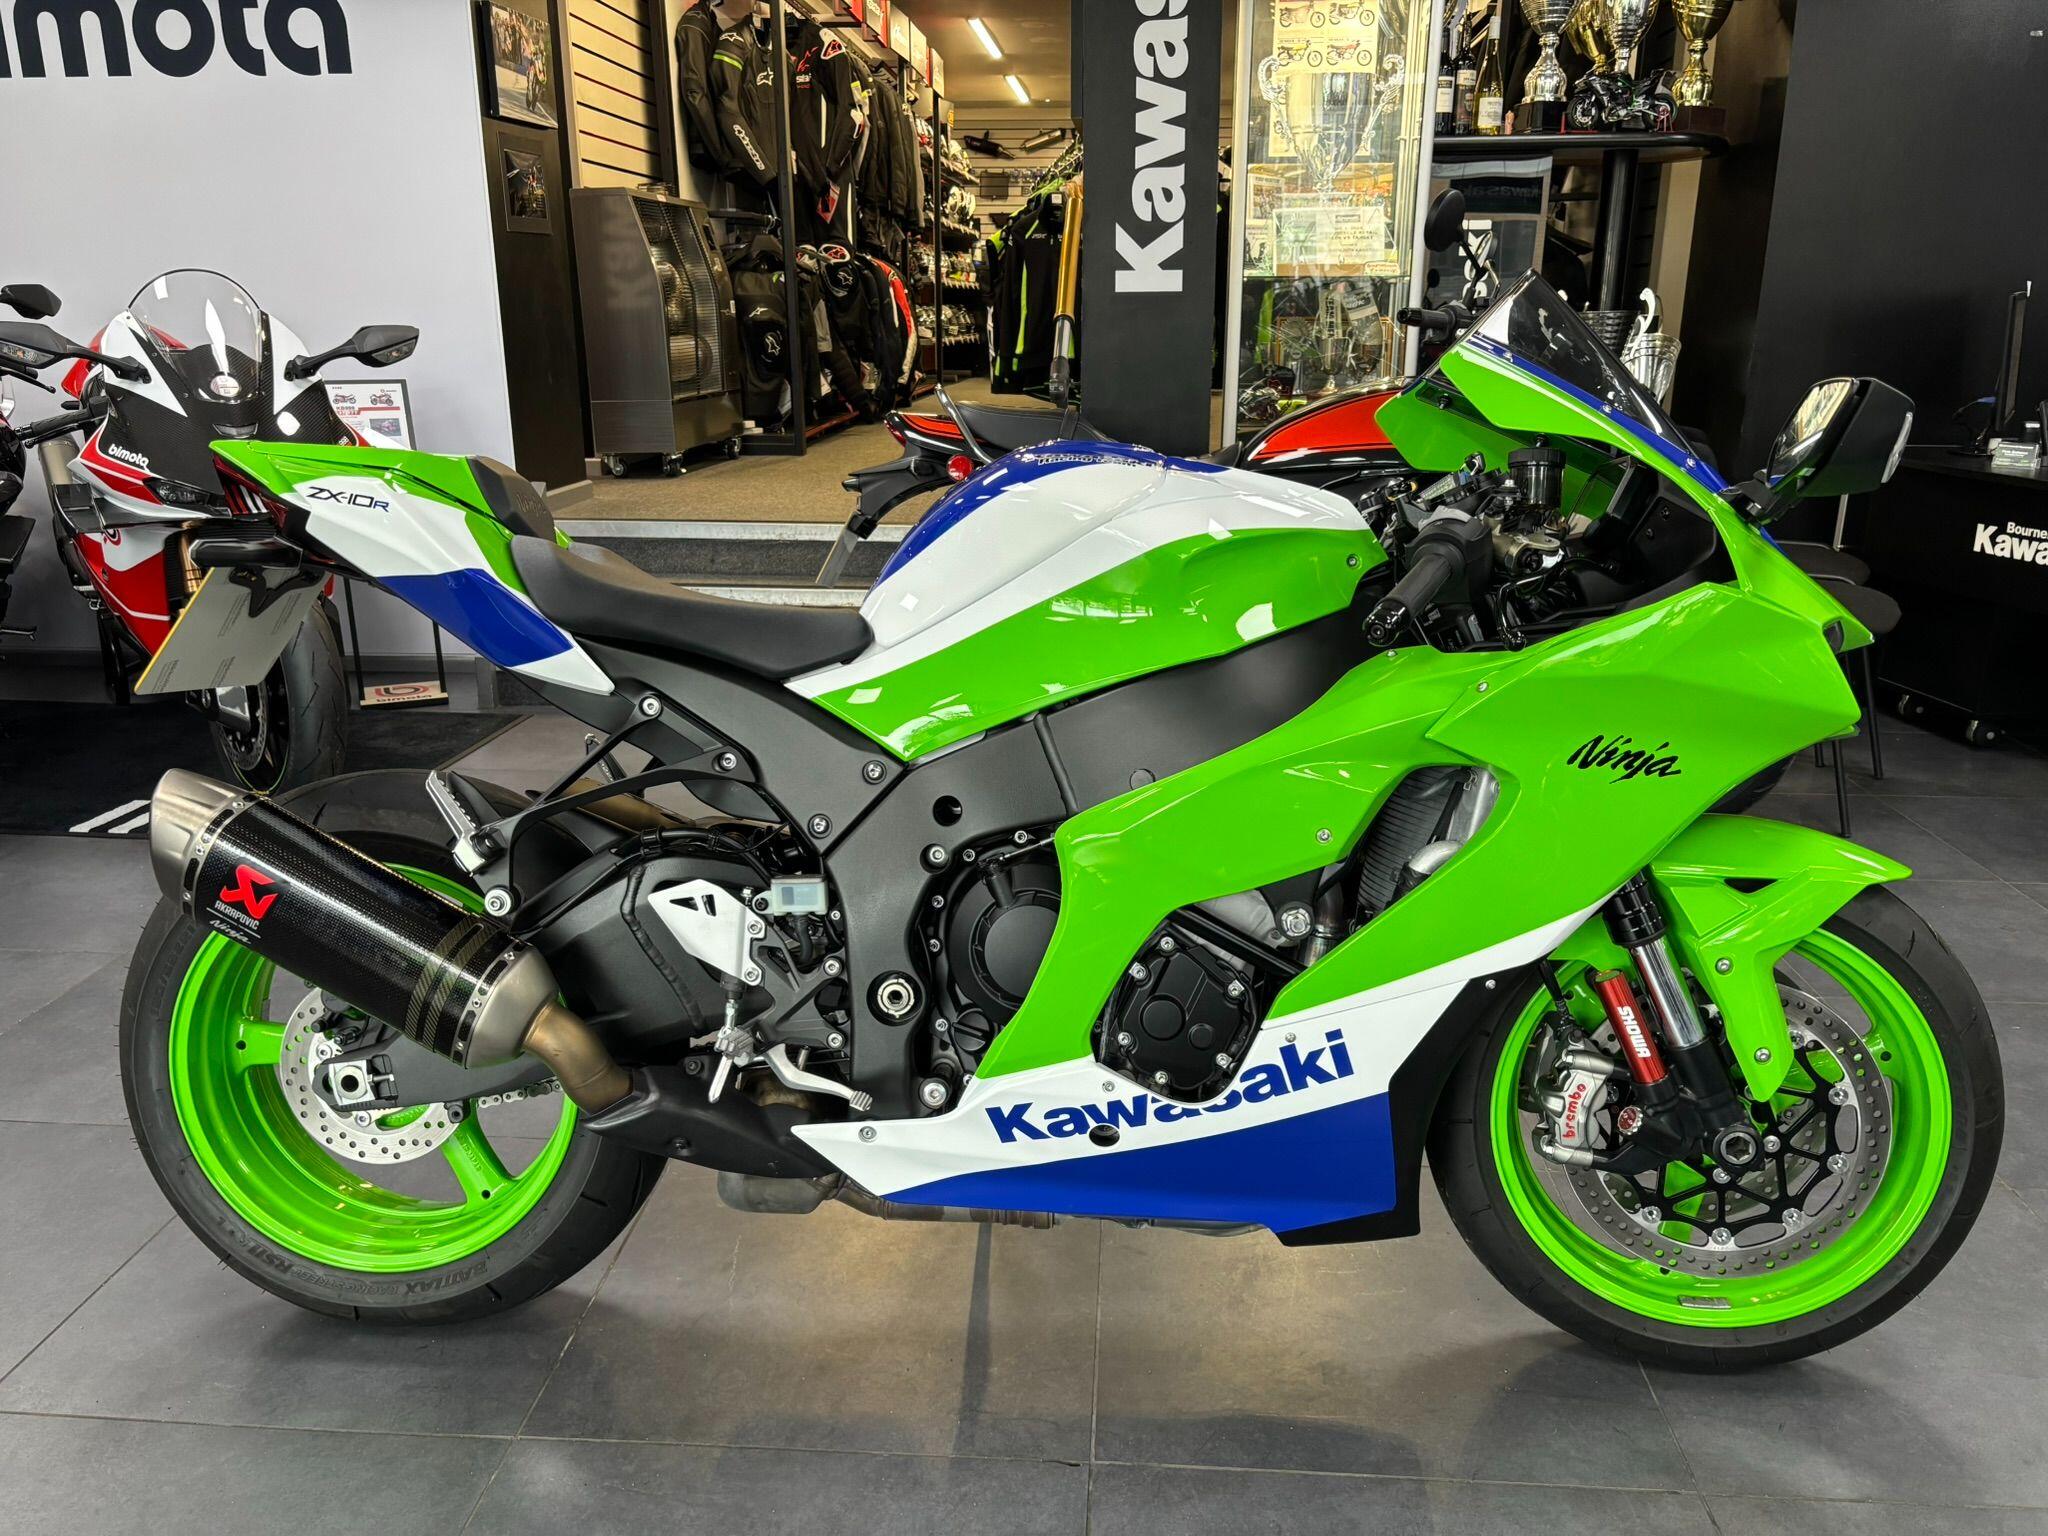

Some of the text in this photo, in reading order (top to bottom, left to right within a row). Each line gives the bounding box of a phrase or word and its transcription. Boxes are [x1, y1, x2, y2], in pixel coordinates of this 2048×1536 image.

[0, 0, 353, 78] mota
[1114, 0, 1189, 293] Kawa
[108, 443, 150, 467] bimota
[305, 486, 390, 513] ZX-10R
[2006, 521, 2048, 540] Bourne
[1566, 734, 1682, 785] Ninja
[208, 919, 253, 945] Ninja
[1617, 1005, 1652, 1059] SHOWA
[1562, 1083, 1587, 1142] brembo
